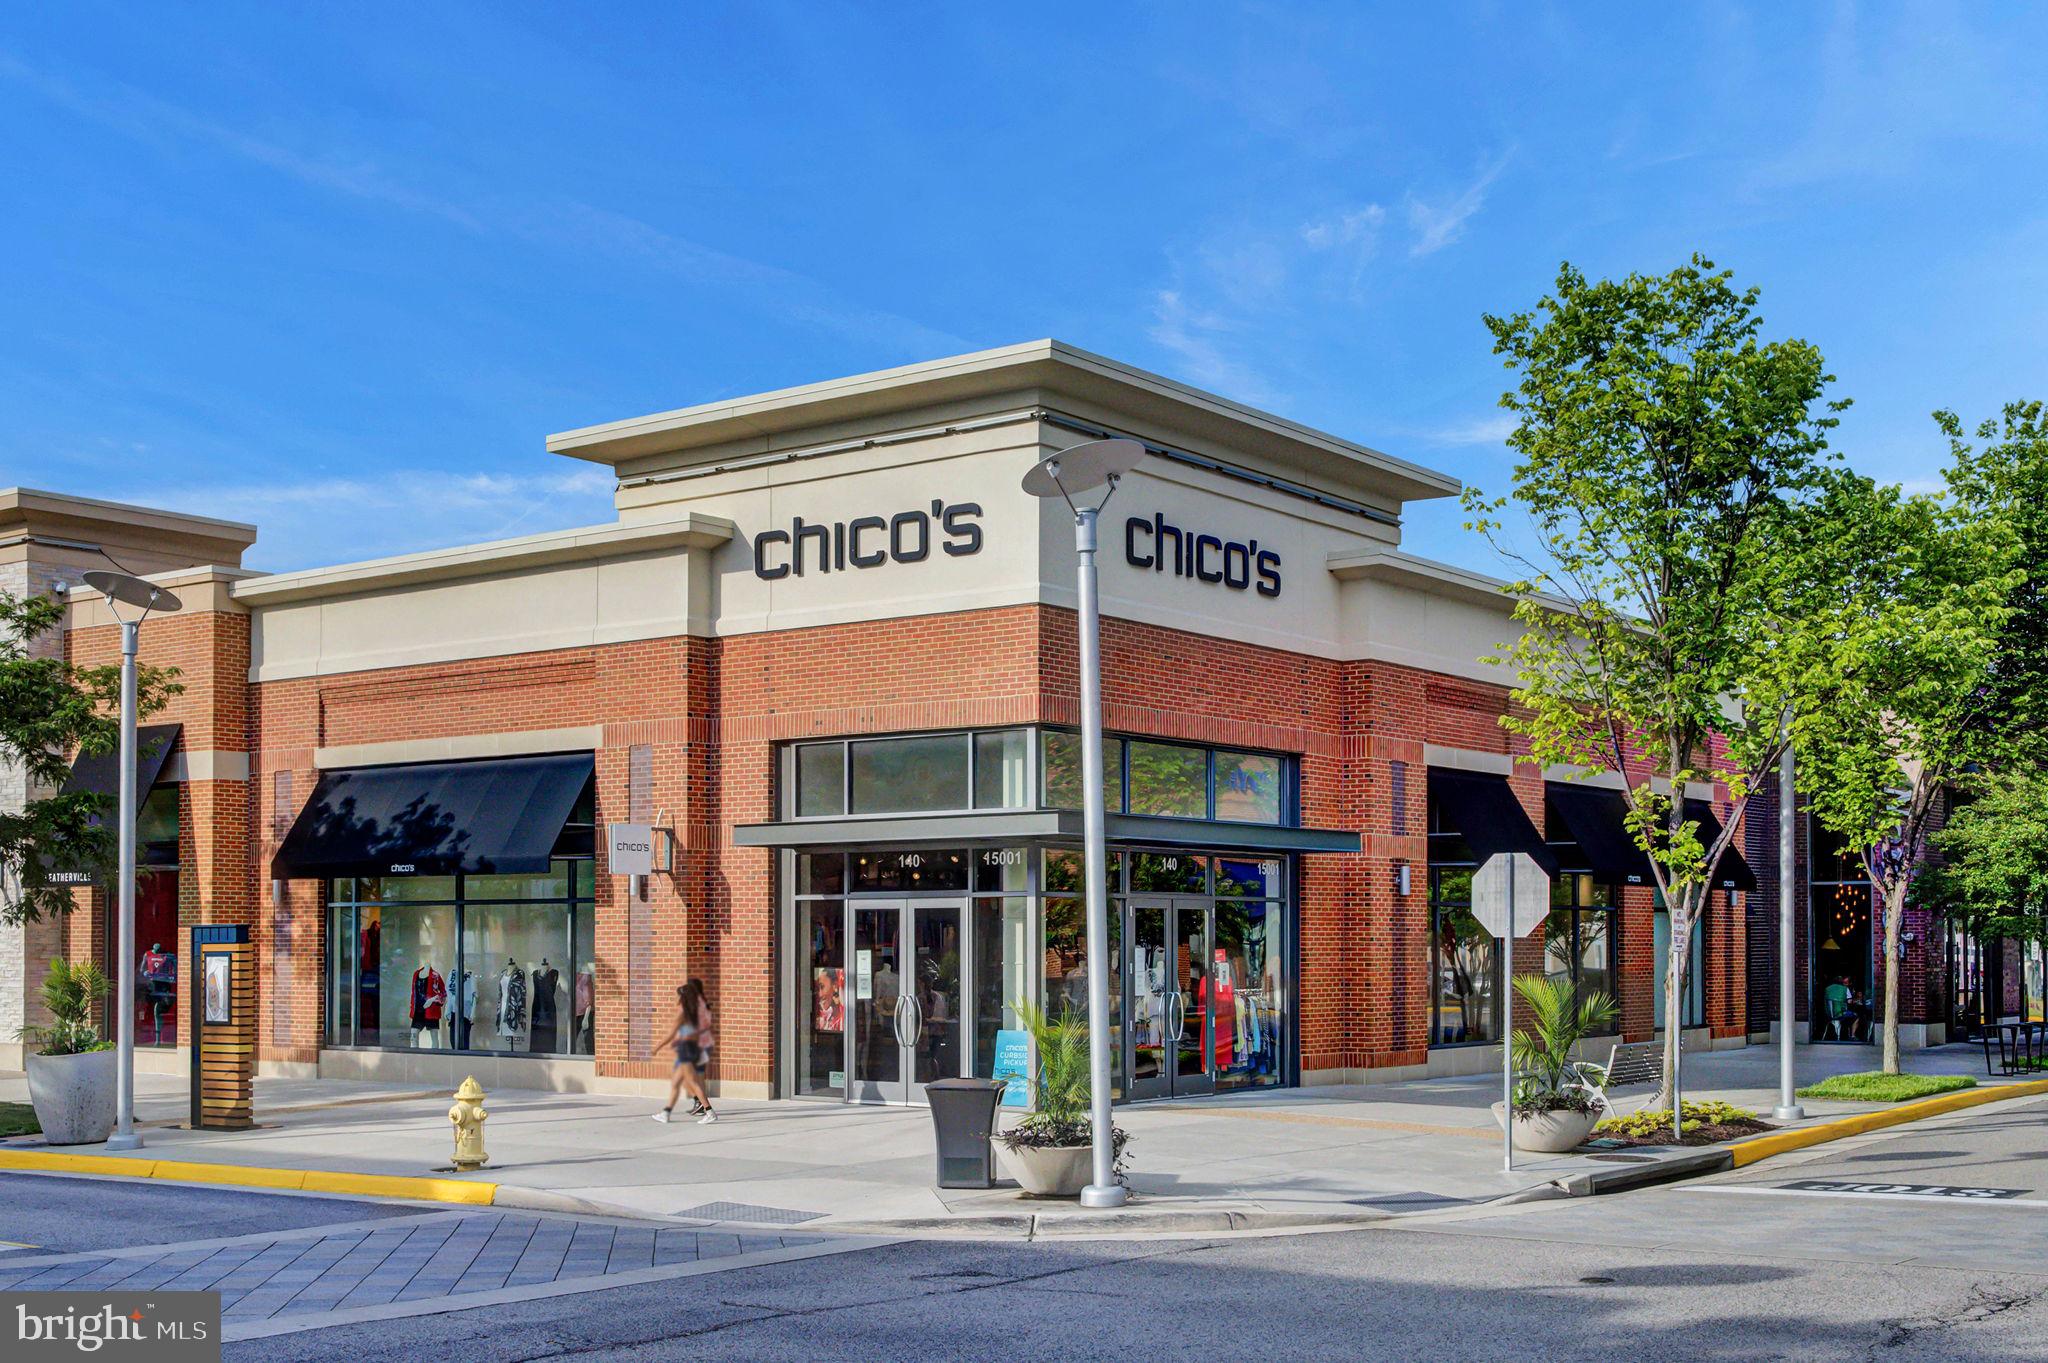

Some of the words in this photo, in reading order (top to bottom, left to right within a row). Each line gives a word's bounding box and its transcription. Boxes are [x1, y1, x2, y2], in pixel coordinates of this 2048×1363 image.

[754, 499, 982, 580] chico's
[1125, 512, 1282, 597] chico's
[616, 841, 650, 852] chico's
[898, 853, 921, 868] 140
[984, 850, 1022, 866] 15001
[1161, 857, 1178, 871] 140
[1257, 862, 1279, 876] 15001
[44, 872, 92, 882] EATHERVILLE
[1802, 1183, 2008, 1198] STOP
